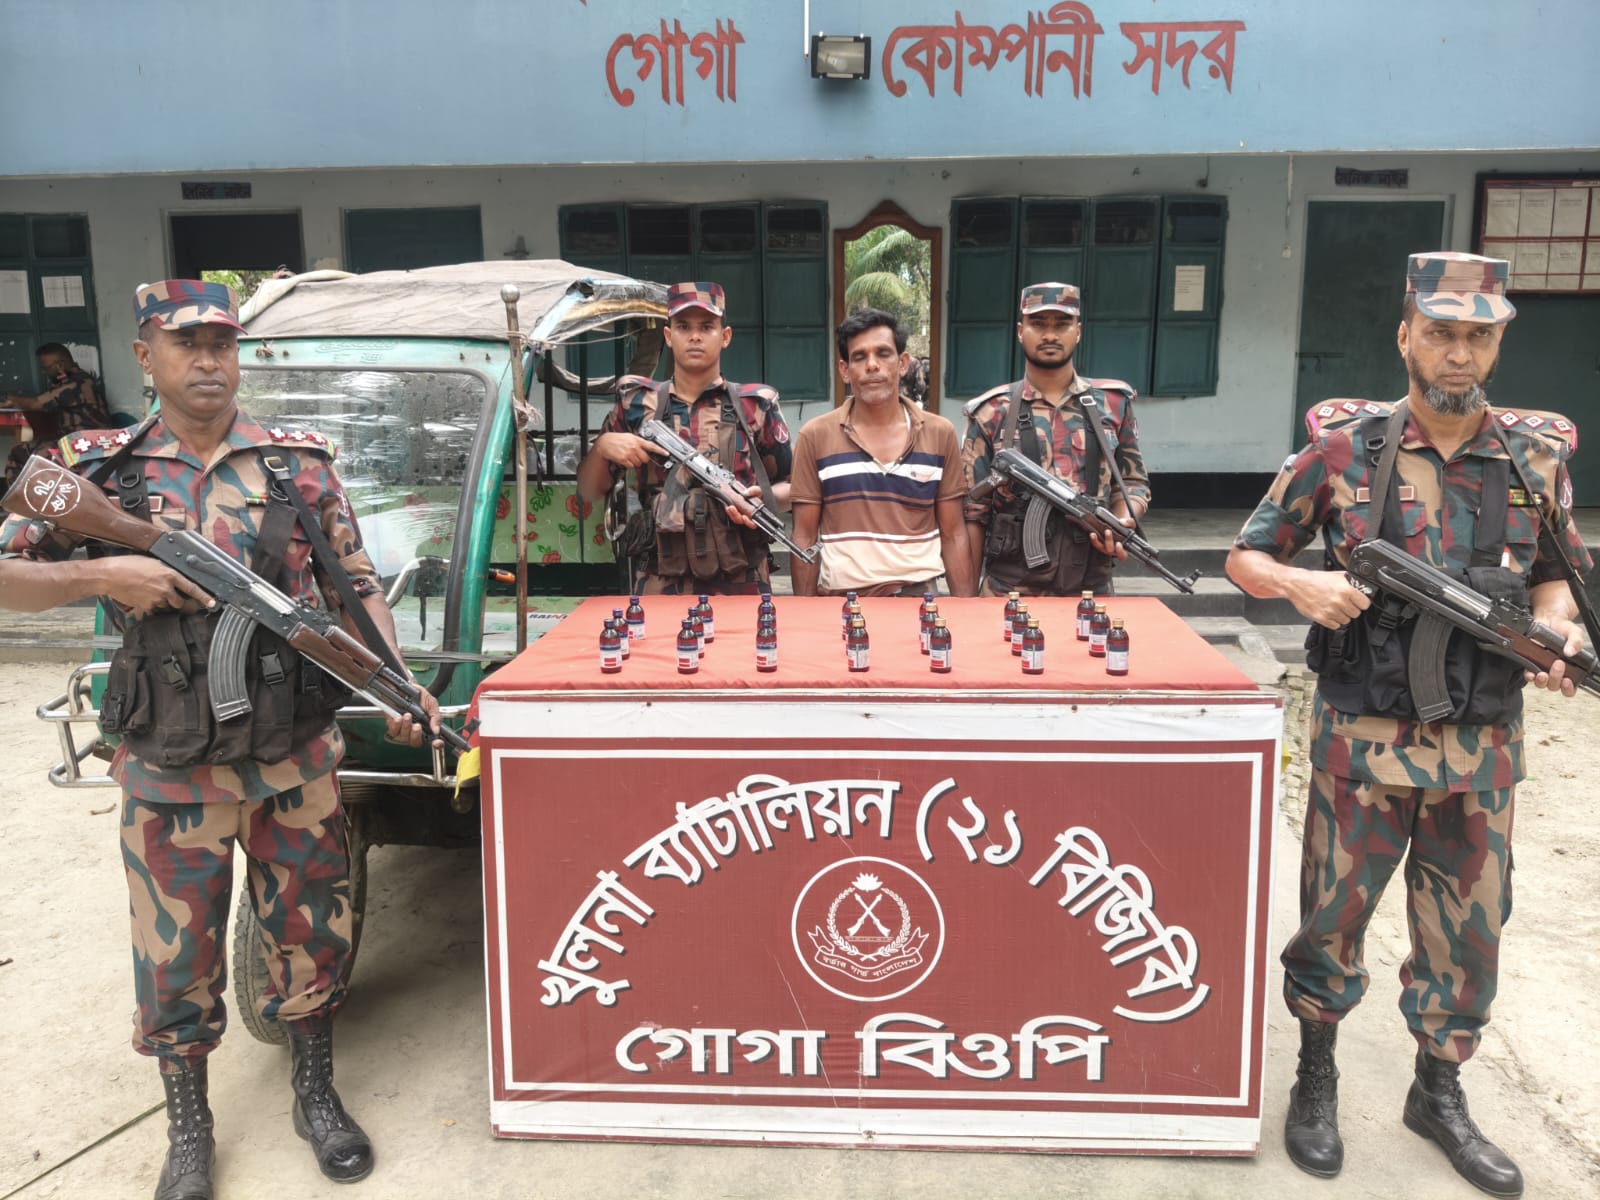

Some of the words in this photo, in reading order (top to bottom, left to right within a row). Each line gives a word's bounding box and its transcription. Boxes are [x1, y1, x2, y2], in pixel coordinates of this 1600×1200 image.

[606, 20, 743, 107] গোগা
[882, 0, 1103, 96] কোম্পানী
[1120, 22, 1245, 94] সদর
[538, 871, 654, 1006] খুলনা
[623, 774, 901, 885] ব্যাটালিয়ন
[916, 778, 1021, 865] (২১
[1029, 827, 1210, 1021] বিজিবি)
[616, 1026, 826, 1076] গোগা
[855, 1013, 1109, 1081] বিওপি
